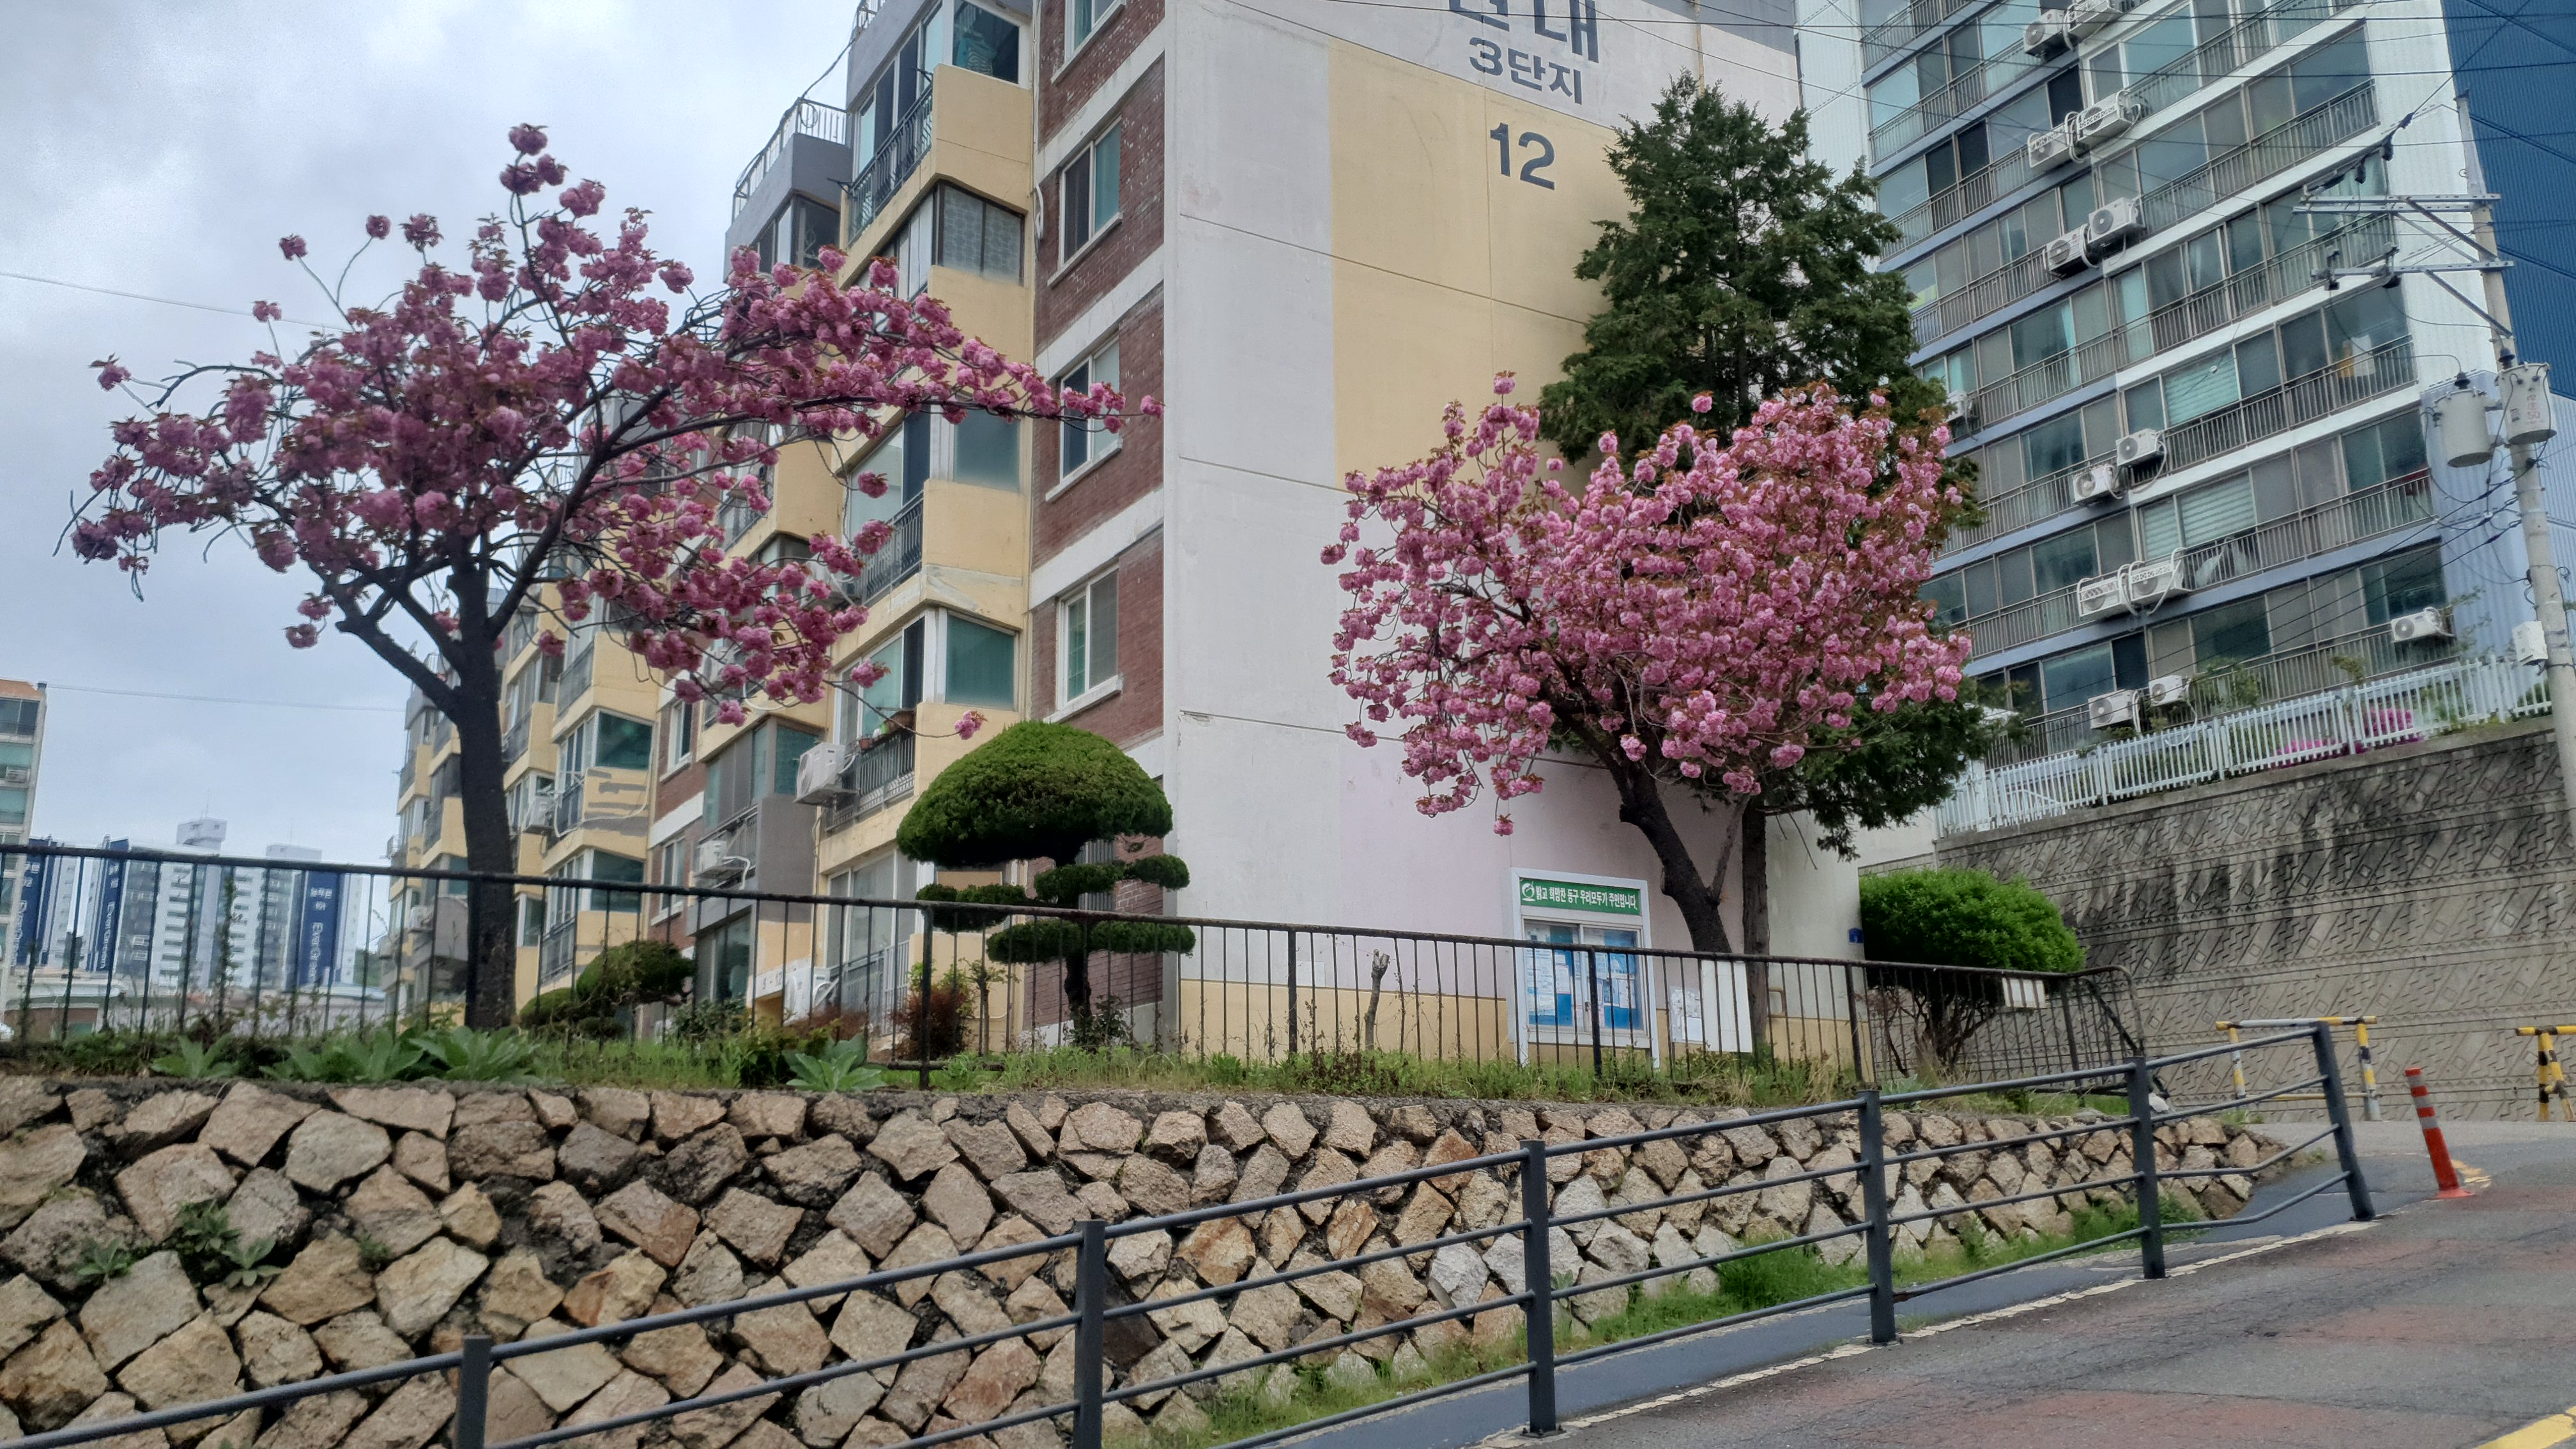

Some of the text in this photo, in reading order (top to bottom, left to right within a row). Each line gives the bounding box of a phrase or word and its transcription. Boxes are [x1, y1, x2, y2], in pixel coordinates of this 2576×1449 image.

[1469, 36, 1583, 105] 3단지
[1490, 122, 1555, 190] 12
[1536, 885, 1547, 900] 밝고
[1549, 887, 1567, 903] 희망찬
[1567, 889, 1579, 904] 동구
[1580, 890, 1607, 907] 우리모두가
